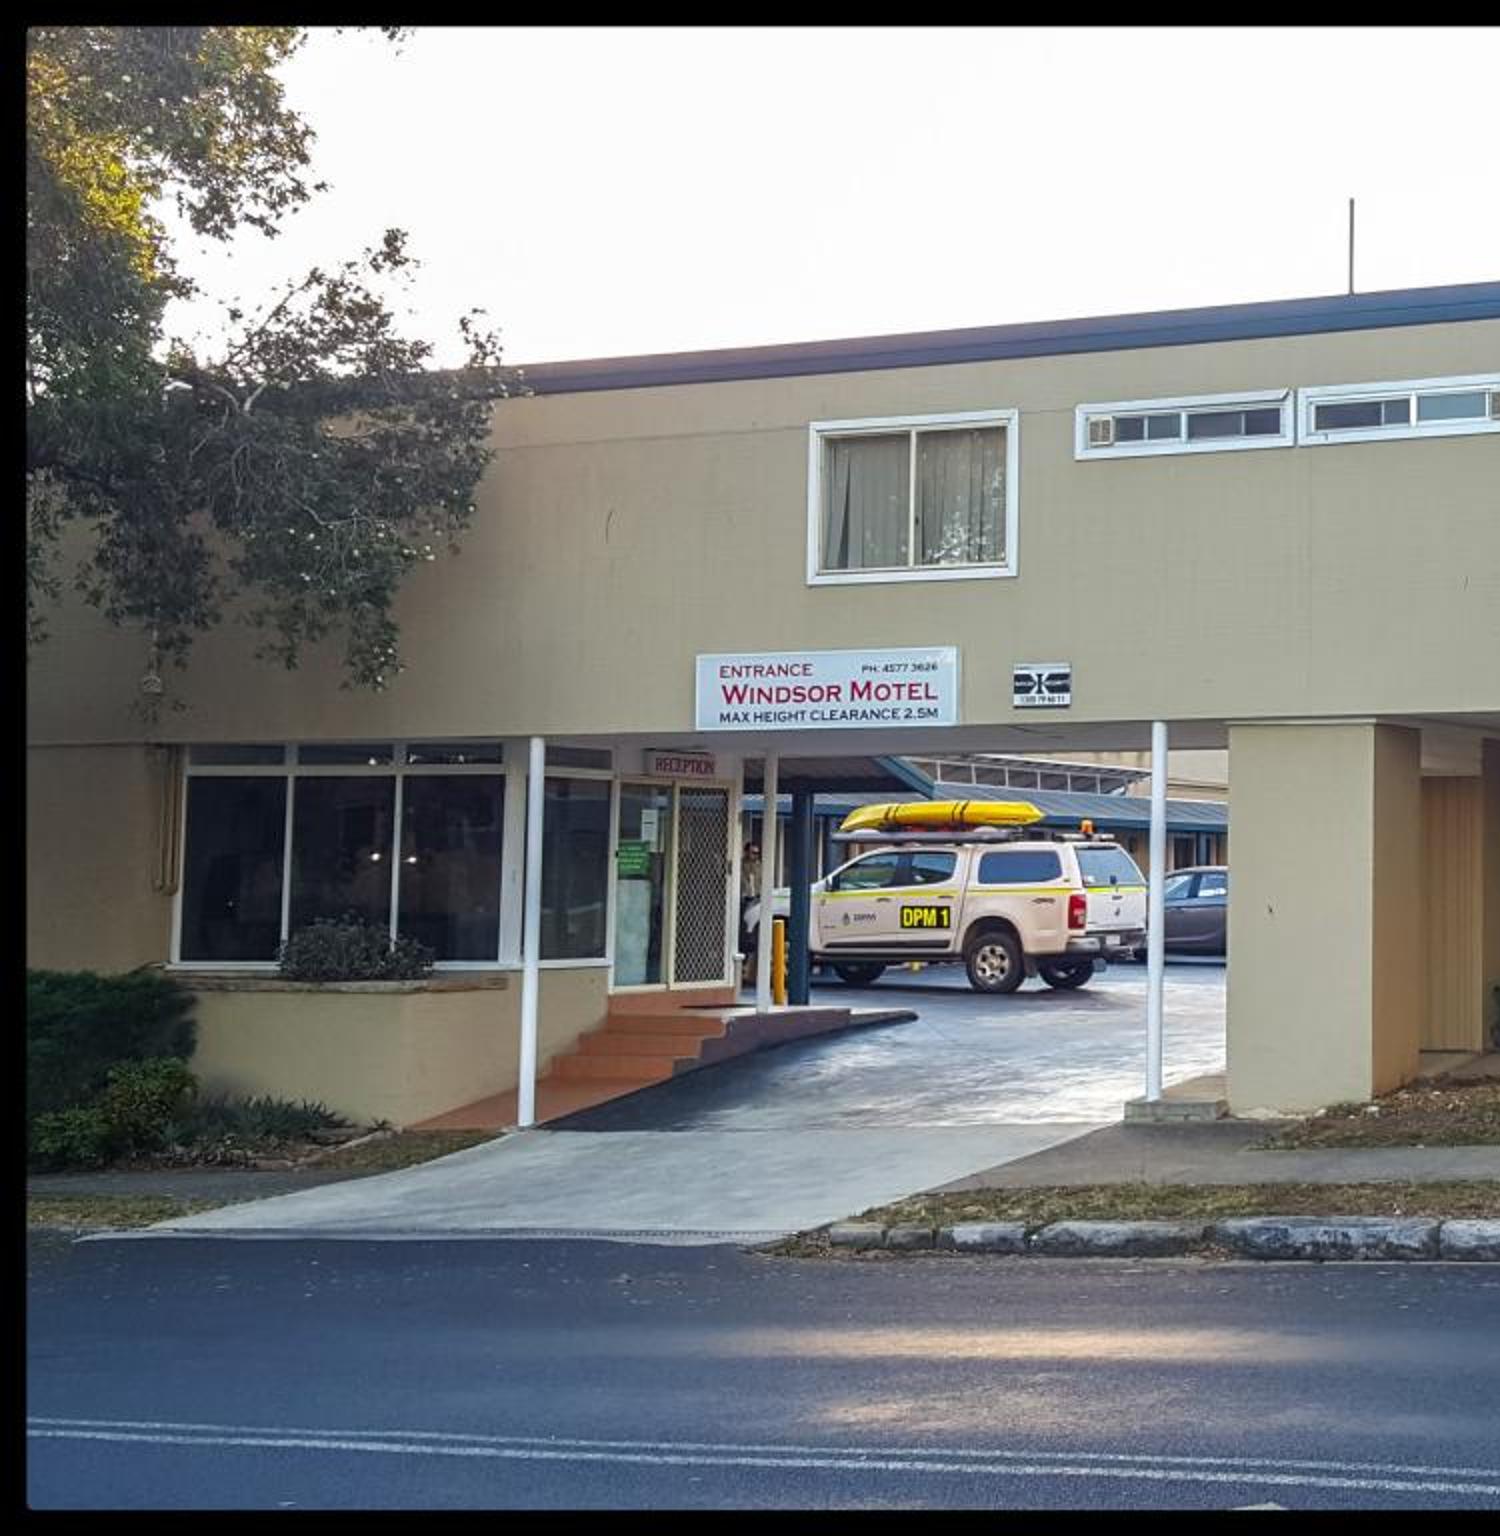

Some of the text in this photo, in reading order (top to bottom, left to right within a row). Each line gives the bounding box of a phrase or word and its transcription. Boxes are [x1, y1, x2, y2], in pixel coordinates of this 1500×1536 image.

[720, 663, 814, 679] ENTRANCE
[861, 664, 880, 673] PH:
[882, 663, 909, 673] 4577
[721, 680, 939, 705] WINDSOR MOTEL
[719, 707, 939, 723] MAX HEIGHT CLEARANCE 2.5M
[655, 757, 715, 775] RECEPTION
[903, 907, 949, 928] DPM 1
